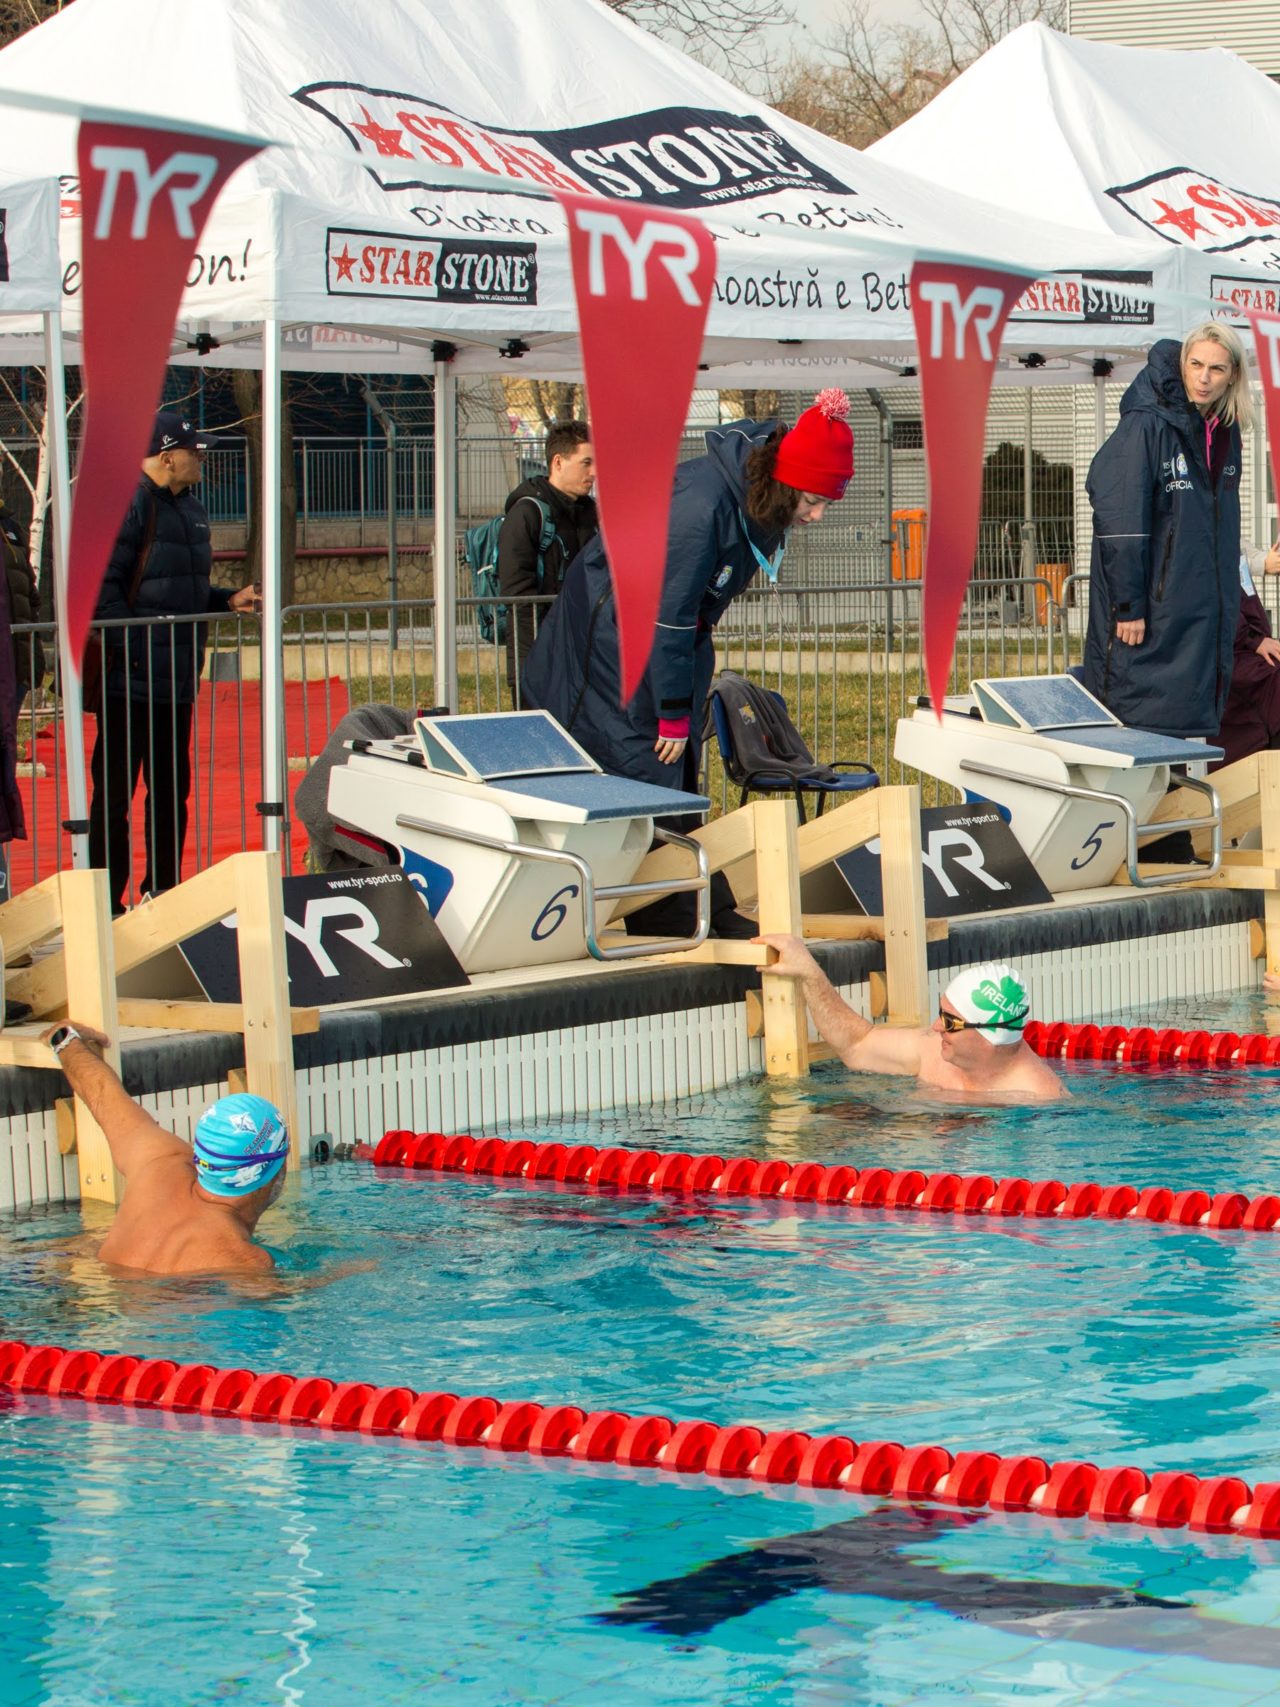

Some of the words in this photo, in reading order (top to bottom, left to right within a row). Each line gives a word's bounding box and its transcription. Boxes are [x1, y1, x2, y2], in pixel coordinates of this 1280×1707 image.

[396, 111, 592, 194] STAR
[91, 146, 219, 241] TYR
[359, 245, 435, 287] STAR
[575, 209, 703, 307] TYR
[836, 281, 851, 310] e
[919, 281, 1005, 361] TYR
[944, 813, 1000, 828] www.tyr-sport.ro
[1070, 821, 1117, 871] 5
[327, 872, 403, 890] www.tyr-sport.ro
[865, 828, 1006, 898] YR
[221, 895, 406, 982] YR
[530, 884, 580, 942] 6
